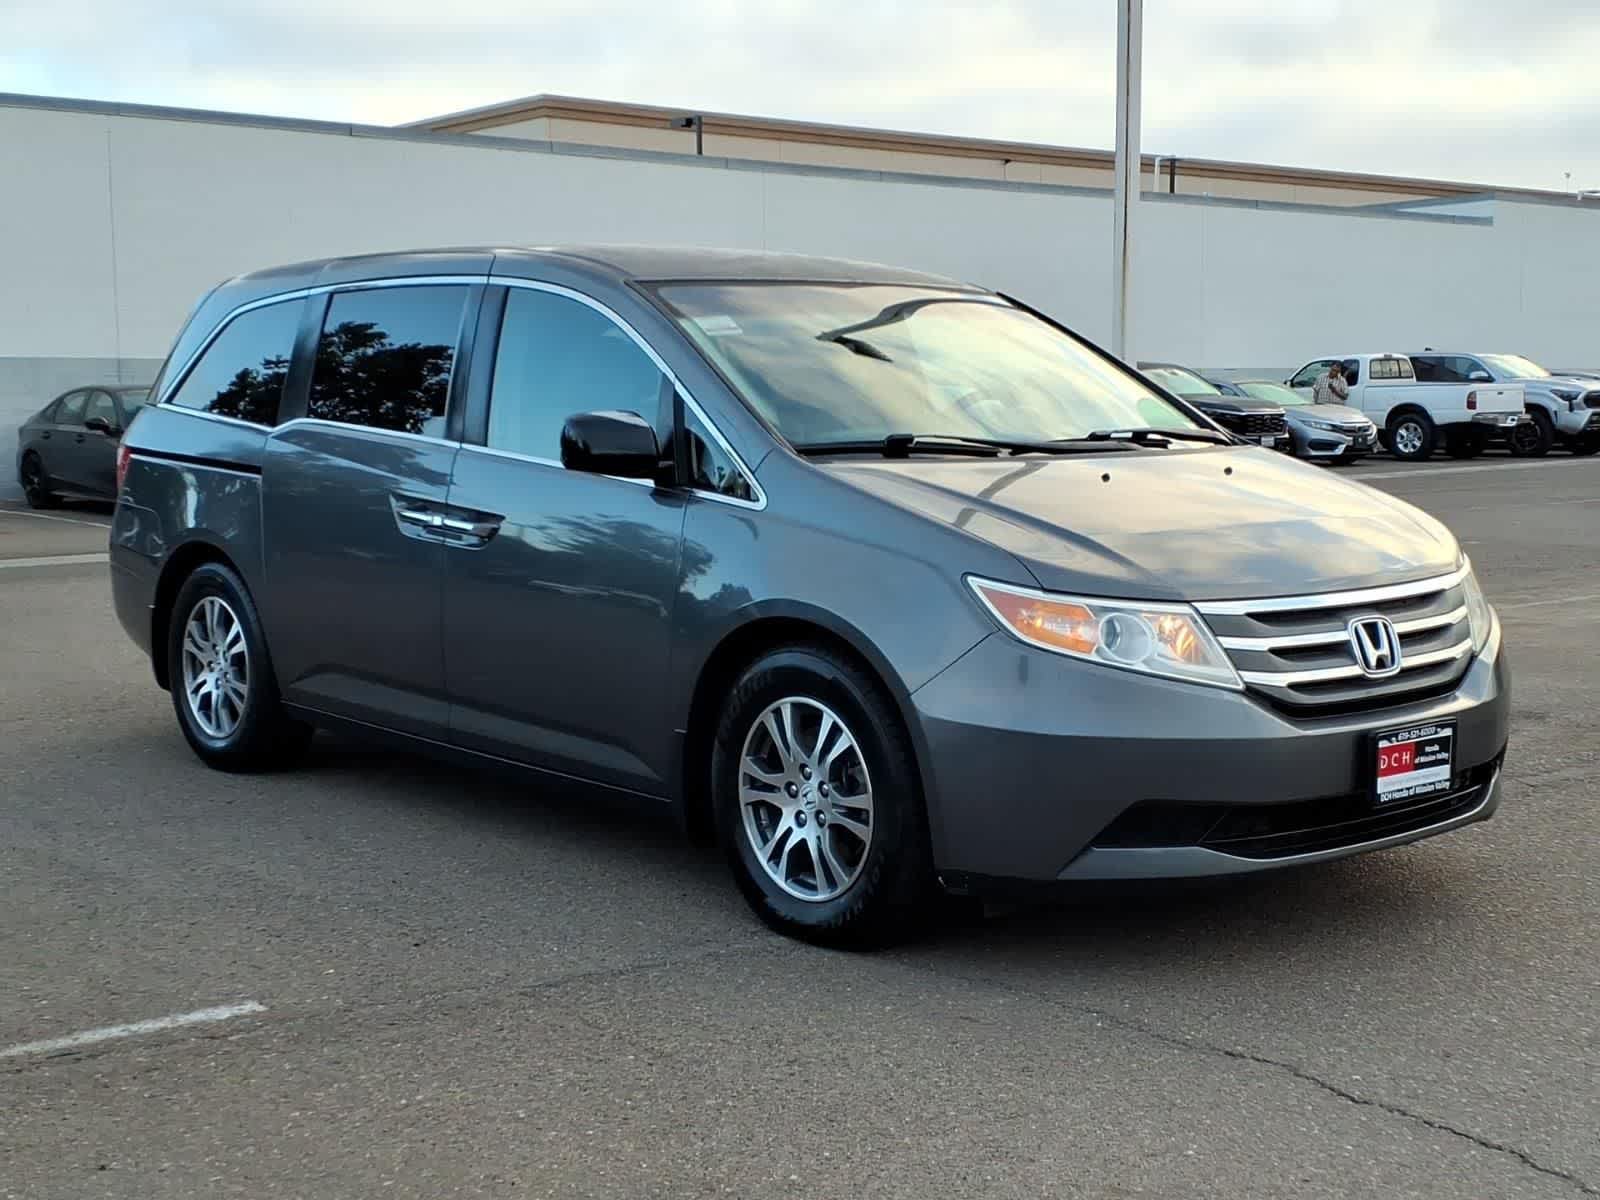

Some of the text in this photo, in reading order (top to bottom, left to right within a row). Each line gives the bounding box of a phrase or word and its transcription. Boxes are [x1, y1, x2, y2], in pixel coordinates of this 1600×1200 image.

[1381, 791, 1392, 802] DCH
[1392, 788, 1409, 800] Honda
[1409, 786, 1415, 795] of
[1435, 780, 1450, 790] Valley
